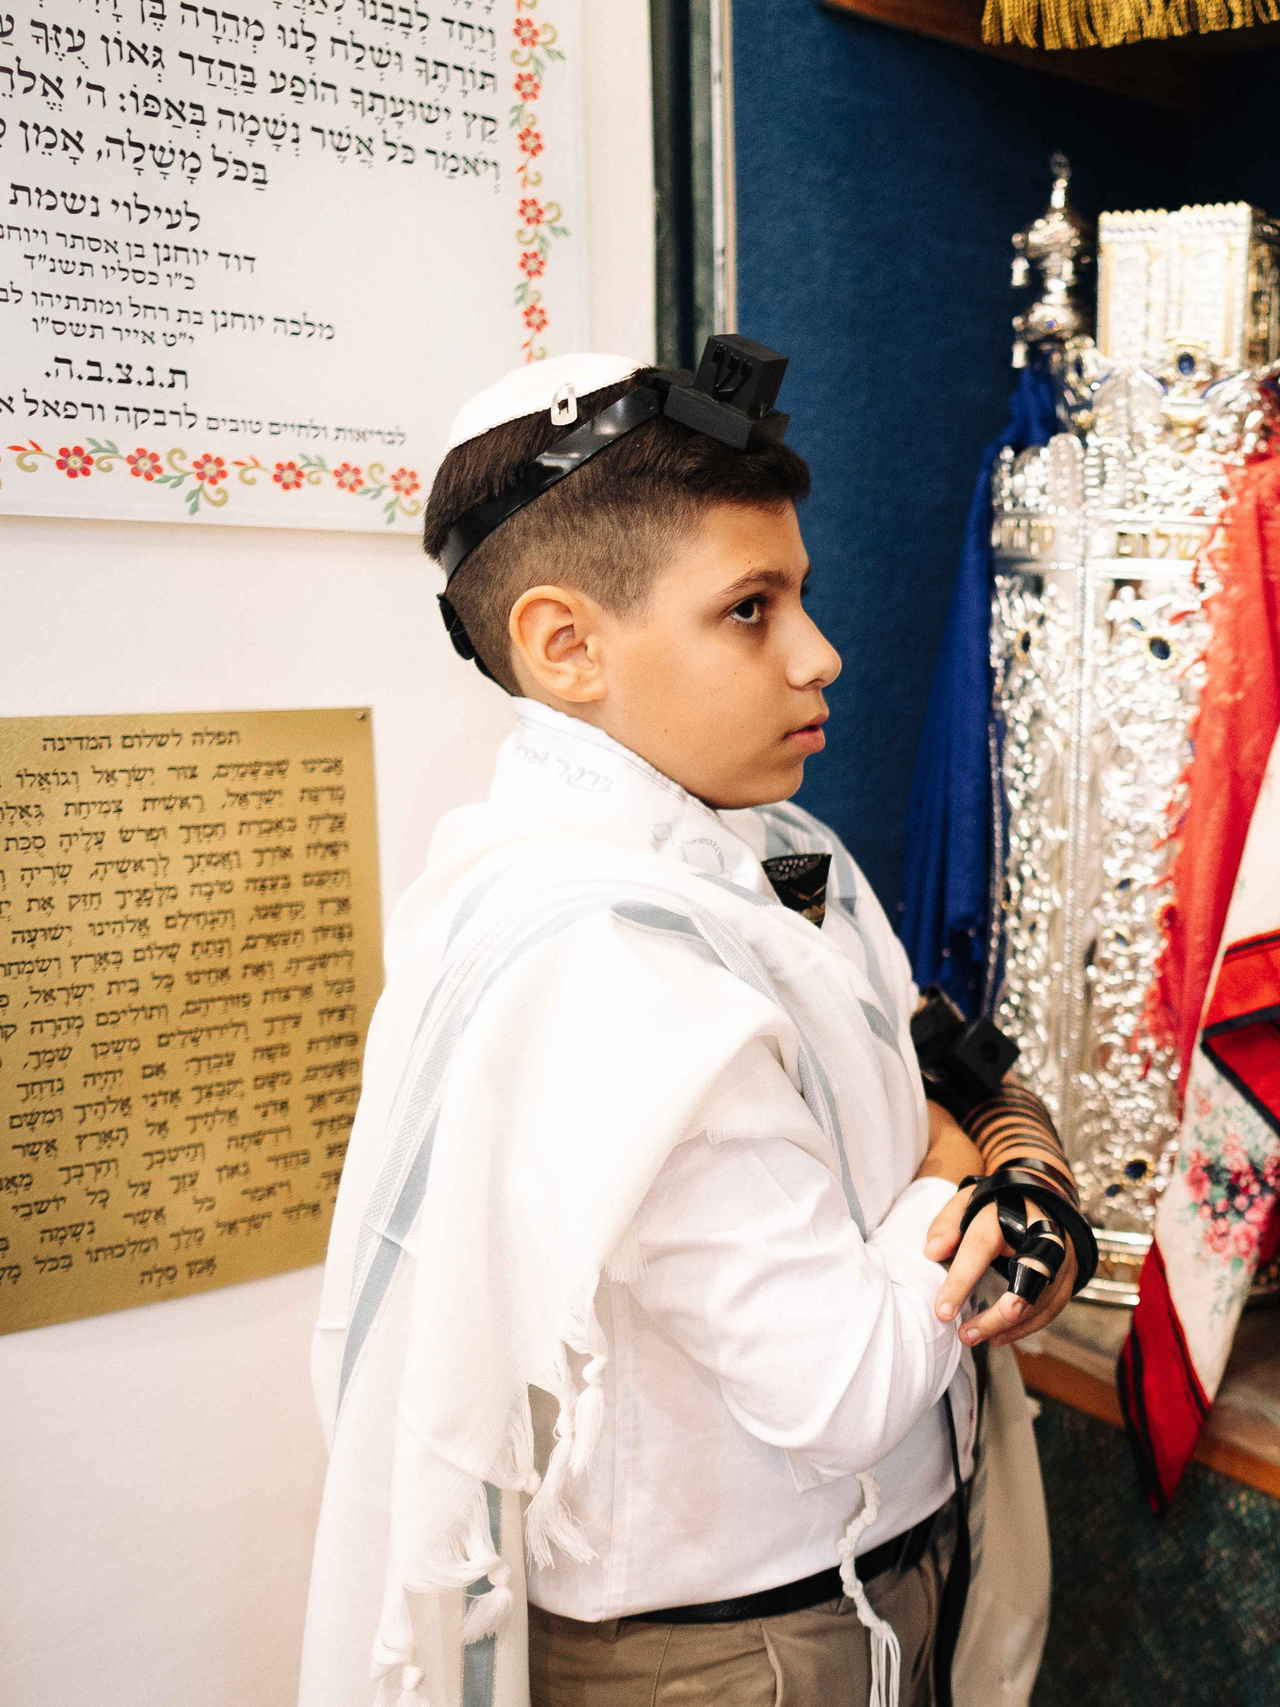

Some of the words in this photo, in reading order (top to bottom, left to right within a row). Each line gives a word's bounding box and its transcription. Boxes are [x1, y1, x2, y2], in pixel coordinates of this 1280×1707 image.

[9, 183, 100, 217] נשמת
[111, 191, 200, 232] לעילוי
[56, 232, 118, 254] אסתר
[125, 242, 146, 262] בן
[153, 242, 209, 267] יוחנן
[101, 259, 159, 286] כסליו
[218, 251, 256, 274] דוד
[0, 281, 23, 304] לב
[31, 290, 122, 316] ומתתיהו
[128, 295, 169, 321] רחל
[176, 308, 203, 325] בת
[210, 309, 264, 333] יוחנן
[273, 311, 336, 340] מלכה
[112, 327, 156, 345] אייר
[44, 356, 189, 390] ת.נ.צ.ב.ה.
[22, 387, 106, 422] ורפאל
[114, 402, 198, 430] לרבקה
[206, 416, 263, 434] טובים
[269, 417, 328, 441] ולחיים
[334, 425, 407, 446] לבריאות
